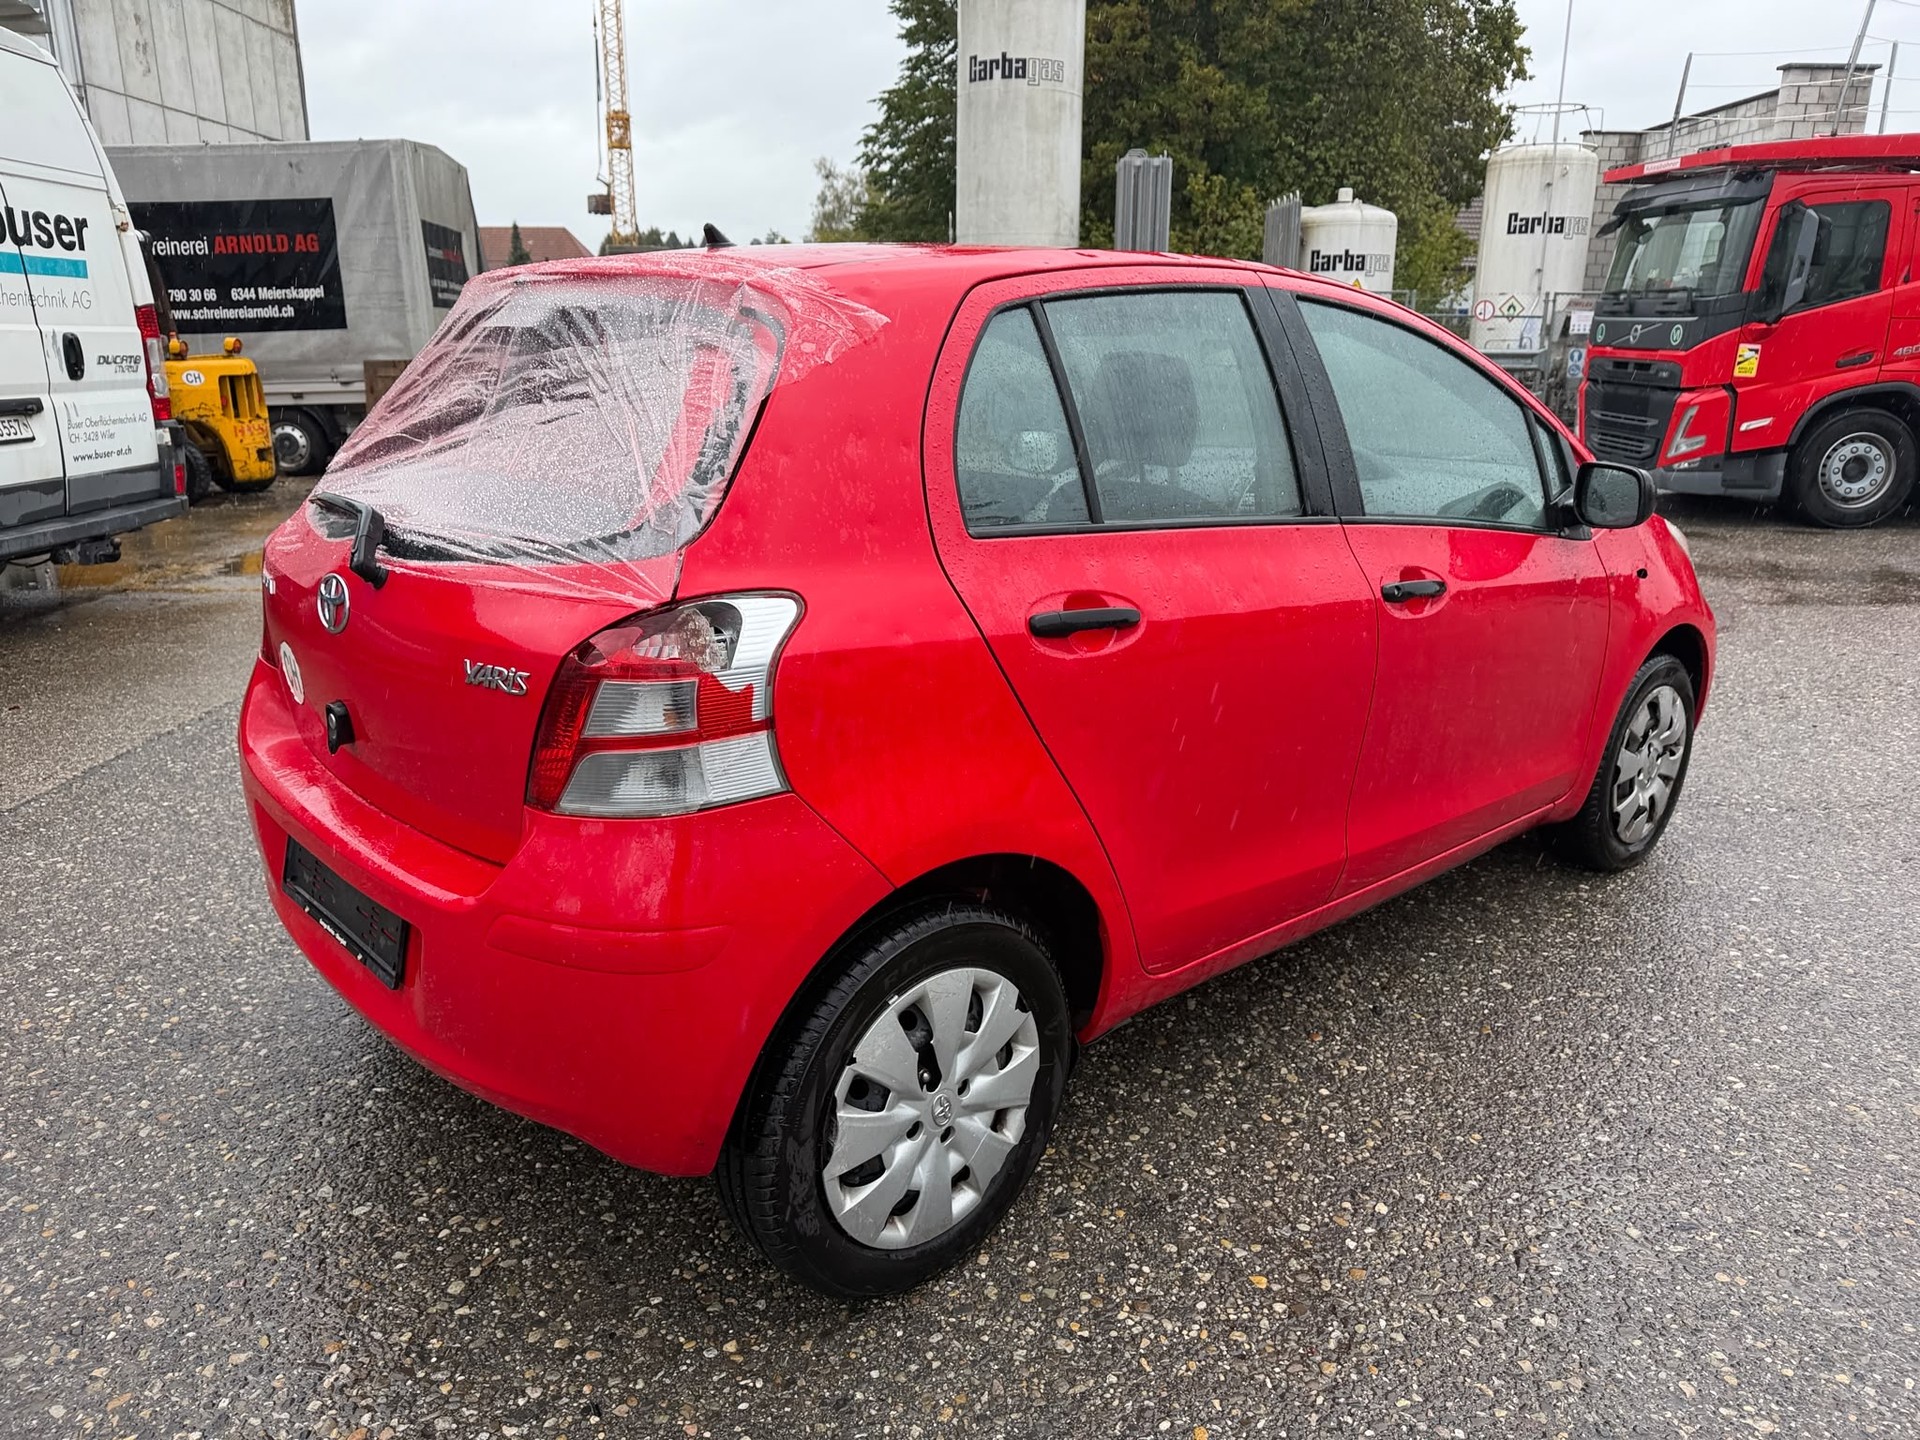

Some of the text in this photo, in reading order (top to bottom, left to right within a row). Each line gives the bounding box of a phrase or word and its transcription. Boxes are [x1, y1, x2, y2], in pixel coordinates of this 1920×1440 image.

[969, 51, 1064, 86] Carbagas
[1507, 211, 1589, 240] Carbagas
[214, 234, 288, 254] ARNOLD
[294, 233, 320, 253] AG
[1310, 249, 1391, 277] Carbagas
[72, 290, 92, 310] AG
[168, 285, 325, 302] 790 30 66 6344 Meierskappel
[185, 372, 202, 384] CH
[138, 412, 148, 422] AG
